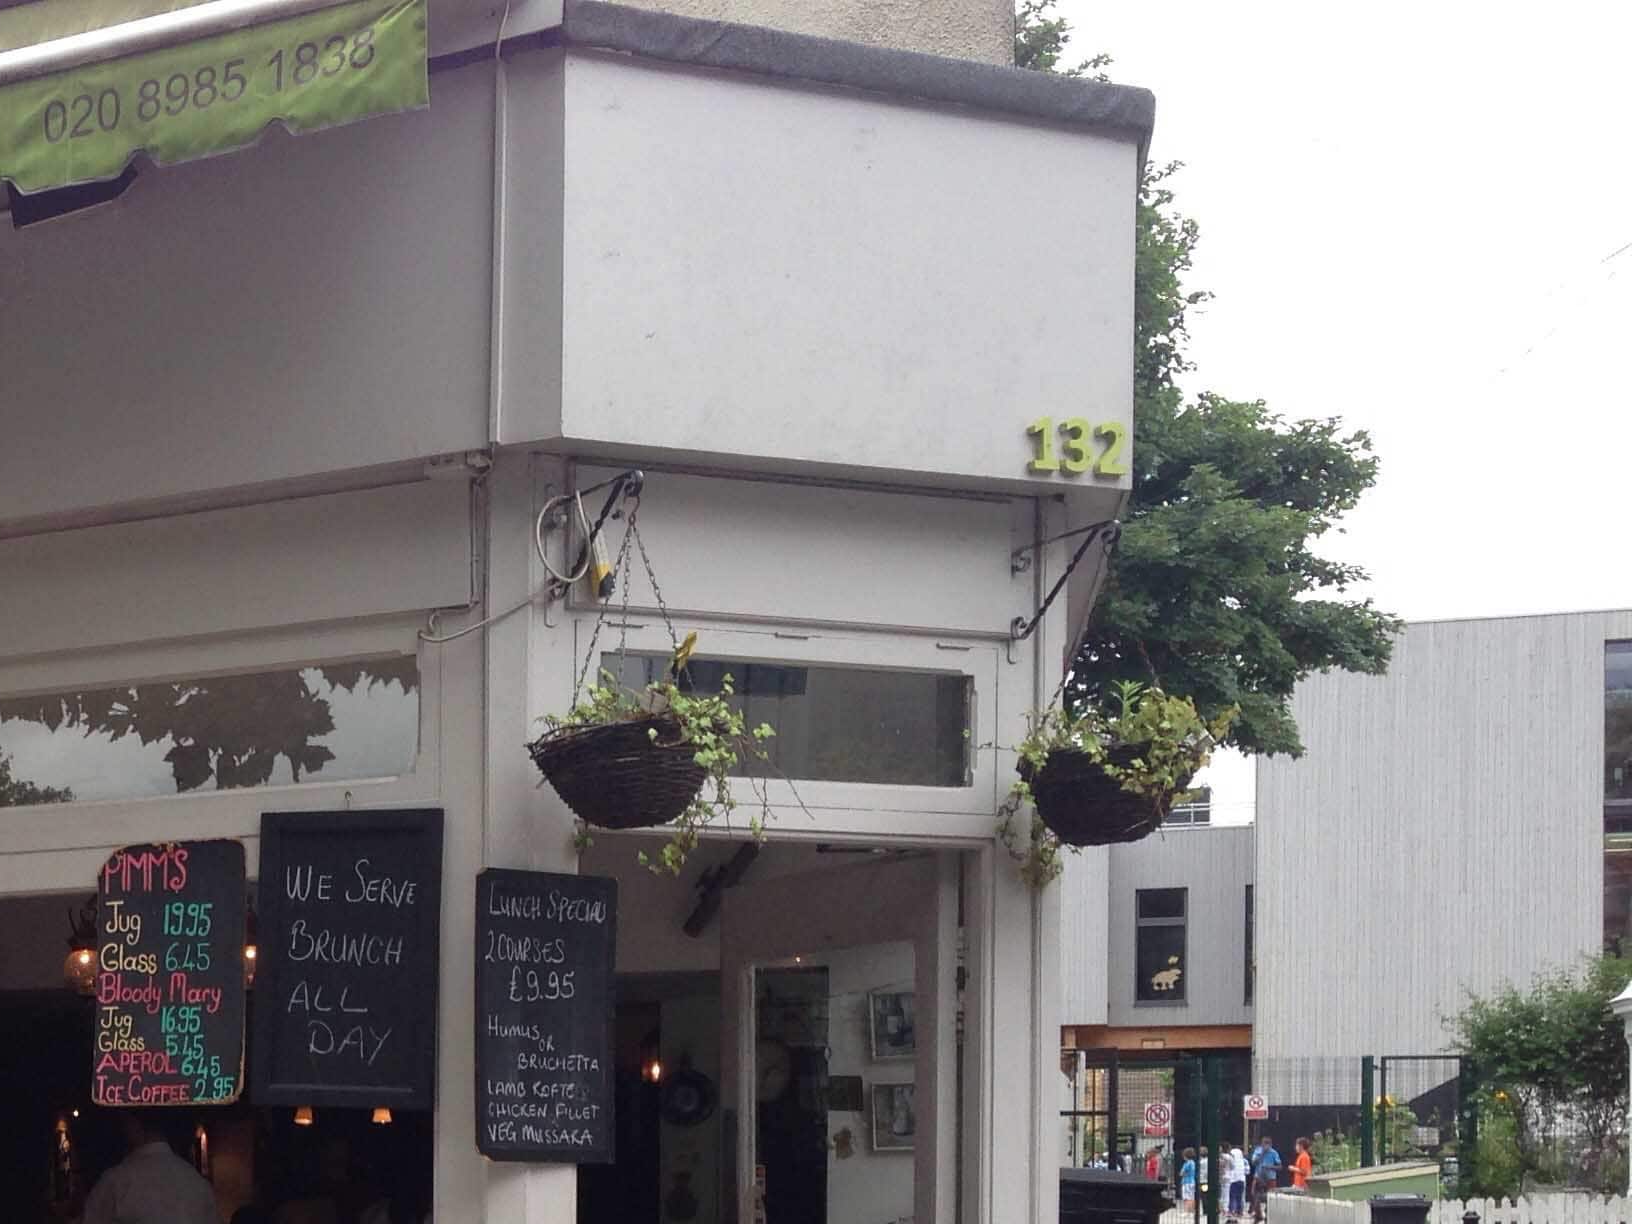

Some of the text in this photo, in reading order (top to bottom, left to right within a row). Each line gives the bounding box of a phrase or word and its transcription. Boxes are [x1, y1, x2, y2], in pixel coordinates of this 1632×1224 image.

[44, 30, 376, 143] 020 8985 1838
[1026, 417, 1127, 478] 132
[286, 858, 417, 908] WE SERVE
[489, 881, 541, 920] LUNCH
[105, 900, 141, 945] Jug
[100, 943, 158, 974] Glass
[288, 919, 403, 966] BRUNCH
[98, 972, 223, 1015] Bloody Mary
[288, 980, 368, 1013] ALL
[100, 1006, 133, 1037] Jug
[98, 1032, 145, 1052] Glass
[308, 1020, 392, 1066] DAY
[97, 1052, 178, 1074] APEROL
[488, 1080, 526, 1097] LAMB
[488, 1102, 548, 1118] CHICKEN
[488, 1121, 517, 1142] VEG
